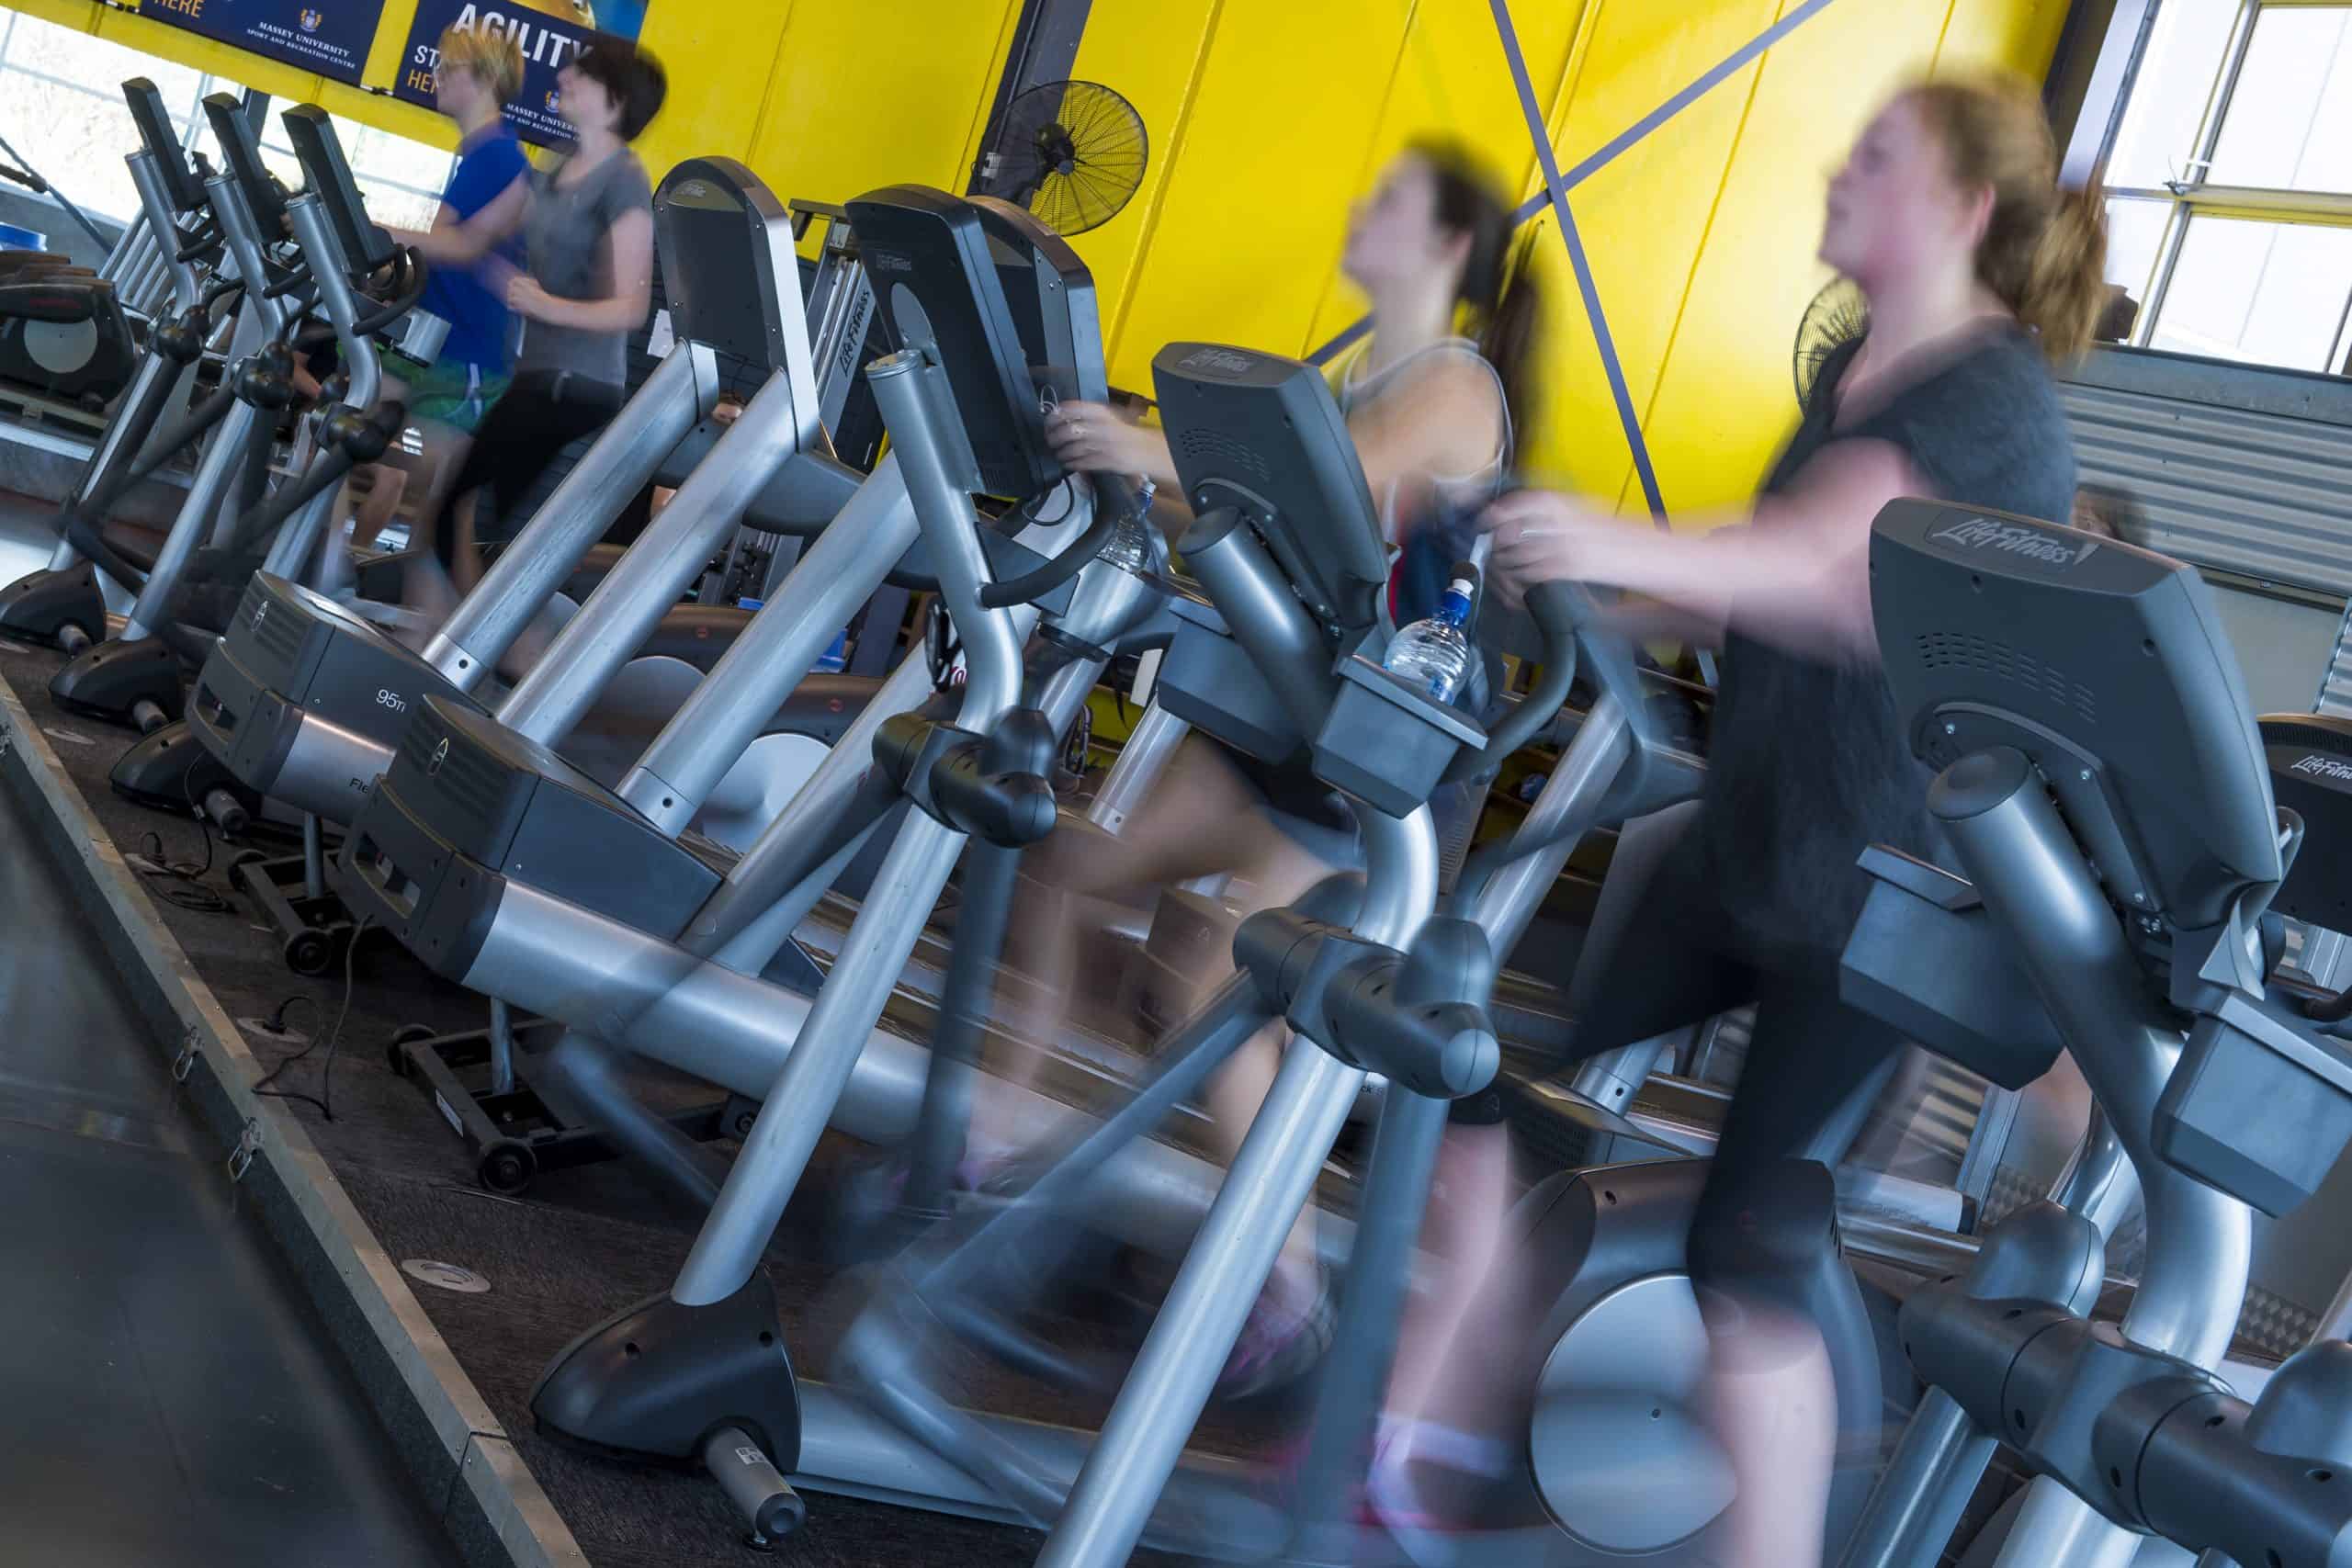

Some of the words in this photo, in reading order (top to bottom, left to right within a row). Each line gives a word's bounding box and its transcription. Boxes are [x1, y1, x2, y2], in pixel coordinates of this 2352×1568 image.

[153, 0, 204, 17] ERE
[258, 21, 295, 39] MASSEY
[295, 32, 351, 58] UNIVERSITY
[270, 35, 286, 45] AND
[506, 102, 539, 120] MASSEY
